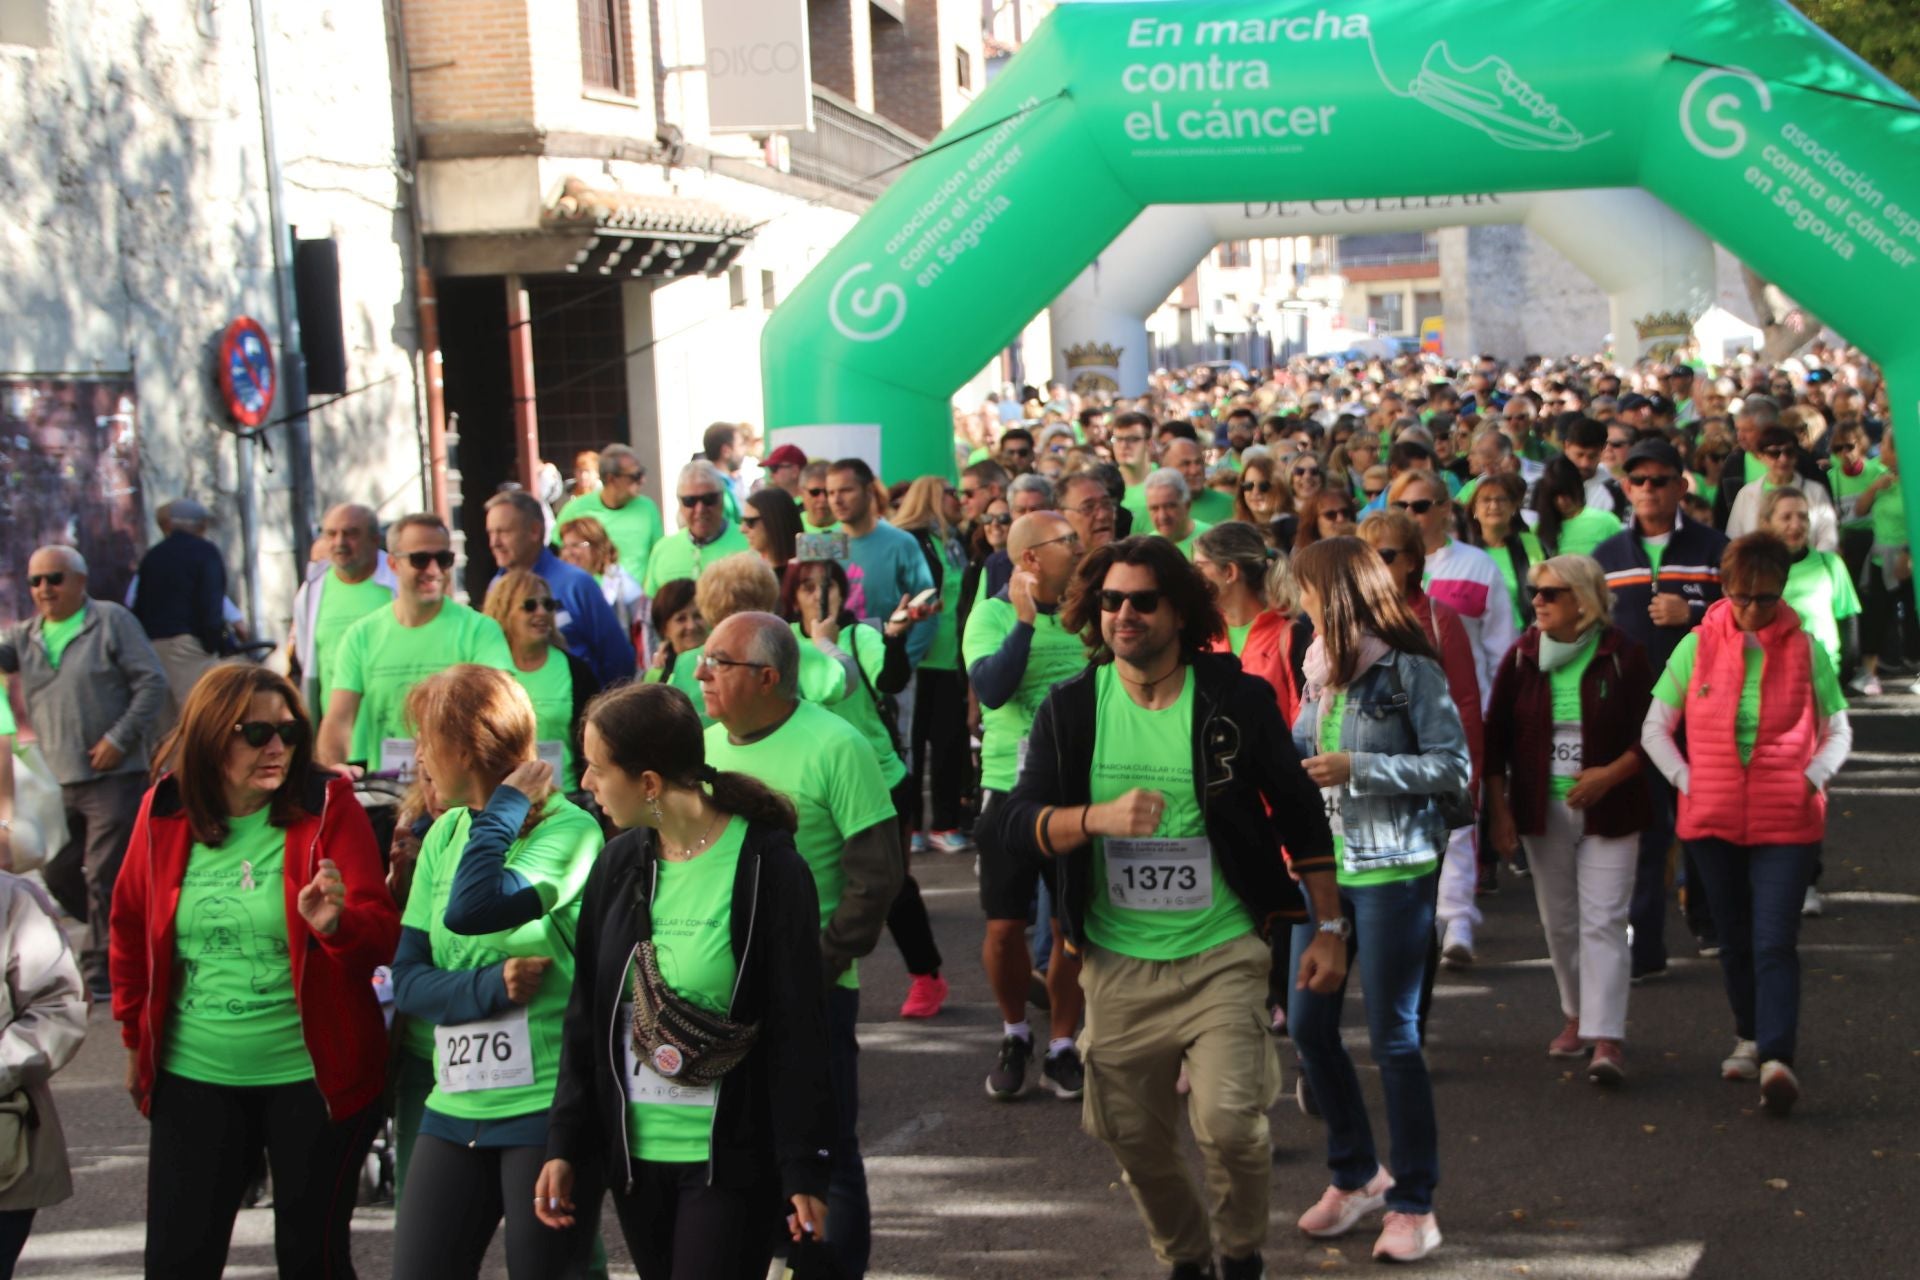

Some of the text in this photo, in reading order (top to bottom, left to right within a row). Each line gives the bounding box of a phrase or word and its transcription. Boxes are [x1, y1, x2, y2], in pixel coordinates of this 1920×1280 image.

[1127, 9, 1370, 48] En marcha
[709, 40, 800, 78] DISCO
[1121, 53, 1270, 93] contra
[1123, 98, 1337, 141] el cáncer
[1780, 123, 1884, 208] asociación
[1744, 166, 1855, 261] en Segovia
[1762, 144, 1916, 268] contra el cáncer
[900, 216, 952, 271] contra
[951, 197, 970, 219] el
[916, 194, 1012, 288] en Segovia
[1122, 865, 1197, 890] 1373
[447, 1031, 512, 1067] 2276
